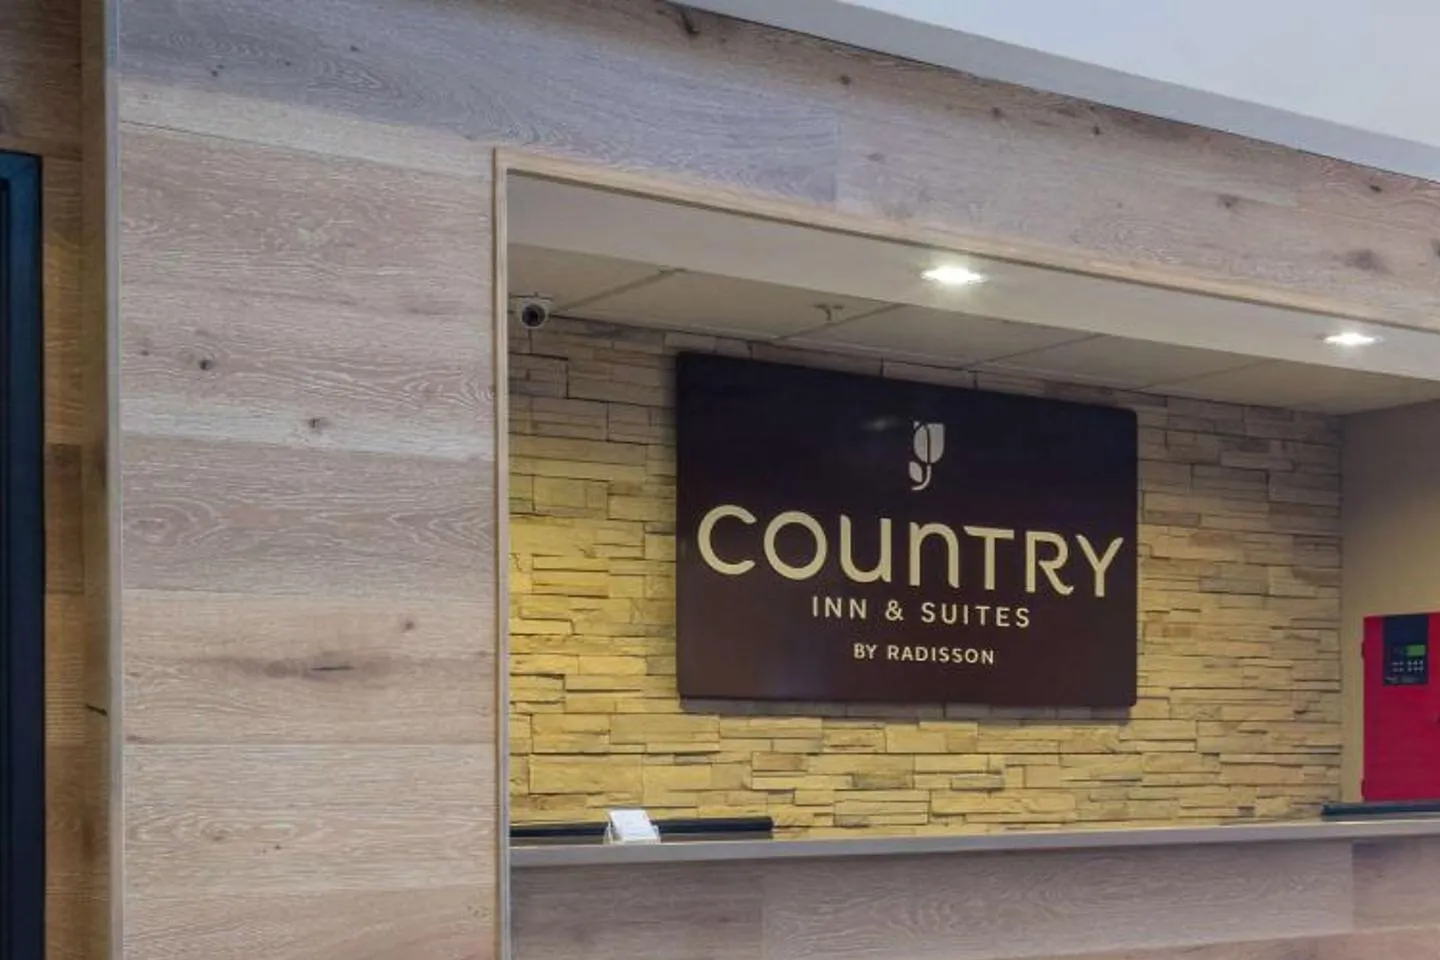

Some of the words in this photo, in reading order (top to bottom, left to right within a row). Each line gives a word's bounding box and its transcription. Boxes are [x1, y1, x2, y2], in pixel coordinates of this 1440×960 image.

[811, 595, 868, 620] INN
[884, 599, 905, 622] &
[920, 601, 1031, 629] SUITES
[853, 642, 878, 661] BY
[886, 644, 995, 666] RADISSON
